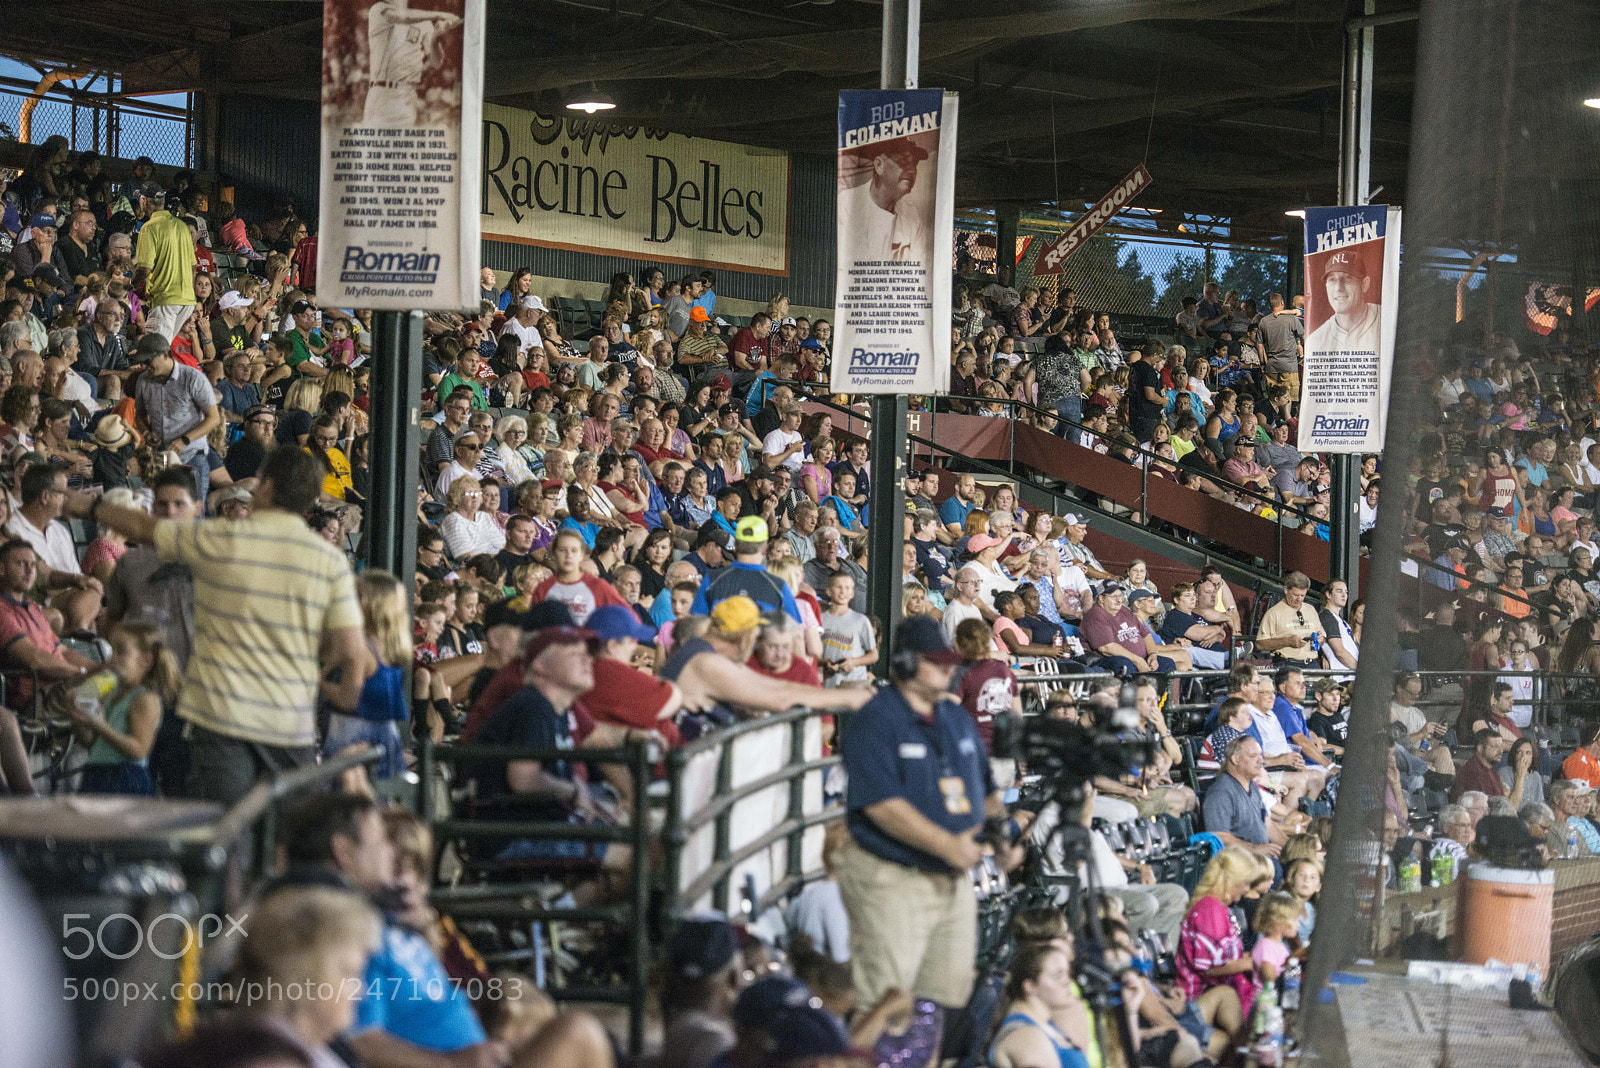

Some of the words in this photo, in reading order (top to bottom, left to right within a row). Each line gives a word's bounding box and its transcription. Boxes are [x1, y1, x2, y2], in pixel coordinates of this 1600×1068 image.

[871, 101, 905, 123] BOB
[343, 128, 375, 136] PLAYED
[378, 128, 402, 137] FIRST
[405, 128, 425, 137] BASE
[429, 129, 444, 137] FOR
[845, 111, 938, 148] COLEMAN
[339, 140, 390, 148] EVANSVILLE
[481, 119, 628, 224] Racine
[644, 155, 764, 243] Belles
[1044, 171, 1144, 269] RESTROOM
[1327, 212, 1365, 231] CHUCK
[1316, 221, 1378, 252] KLEIN
[342, 246, 441, 271] Romain
[1332, 254, 1348, 264] NL
[345, 286, 433, 297] MyRomain.com
[850, 348, 920, 366] Romain
[852, 377, 914, 386] MyRomain.com
[1313, 415, 1369, 429] Romain
